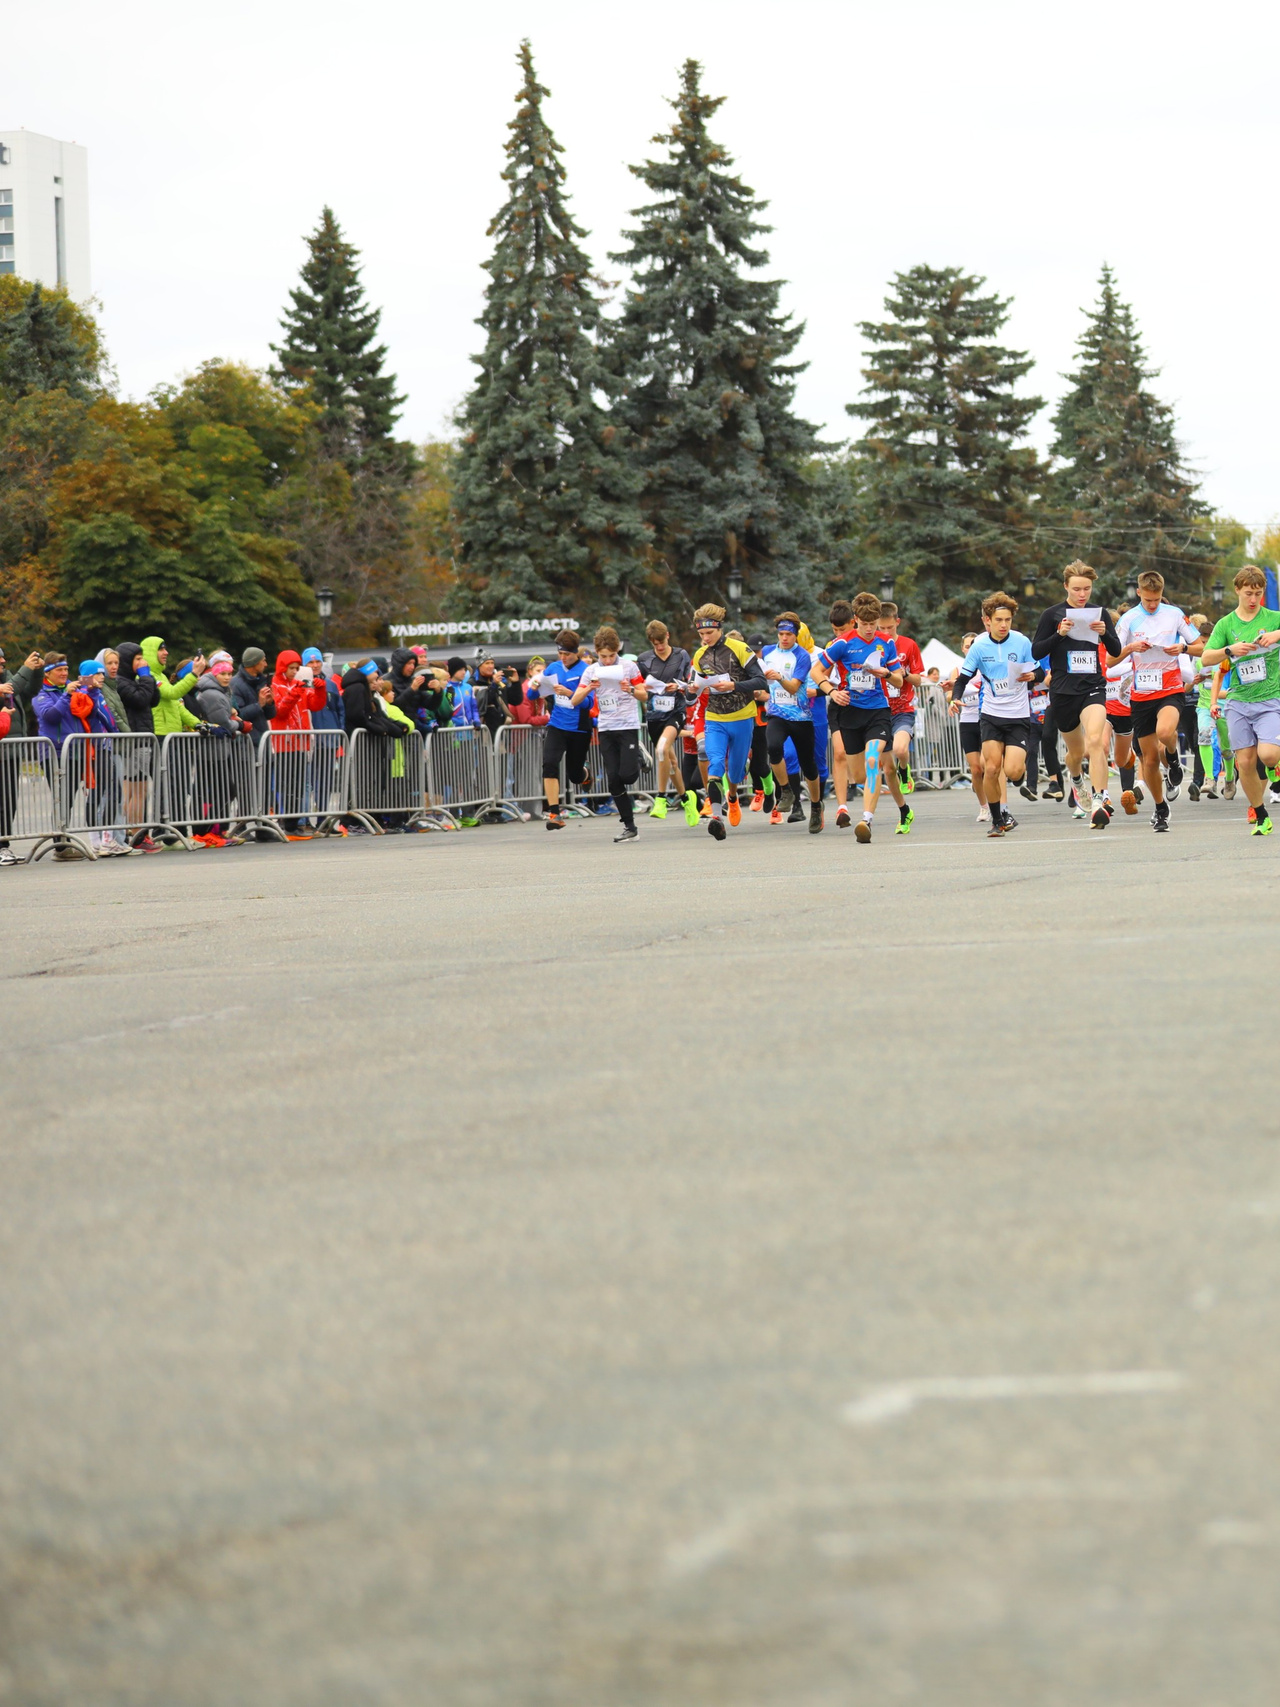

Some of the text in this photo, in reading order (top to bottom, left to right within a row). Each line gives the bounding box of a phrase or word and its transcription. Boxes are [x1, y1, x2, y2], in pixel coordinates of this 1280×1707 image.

[389, 618, 580, 637] УЛЬЯНОВСКАЯ ОБЛАСТЬ
[1071, 656, 1093, 665] 308.1
[1240, 665, 1261, 675] 312.1
[852, 675, 872, 683] 302.1
[599, 698, 615, 706] 342.1
